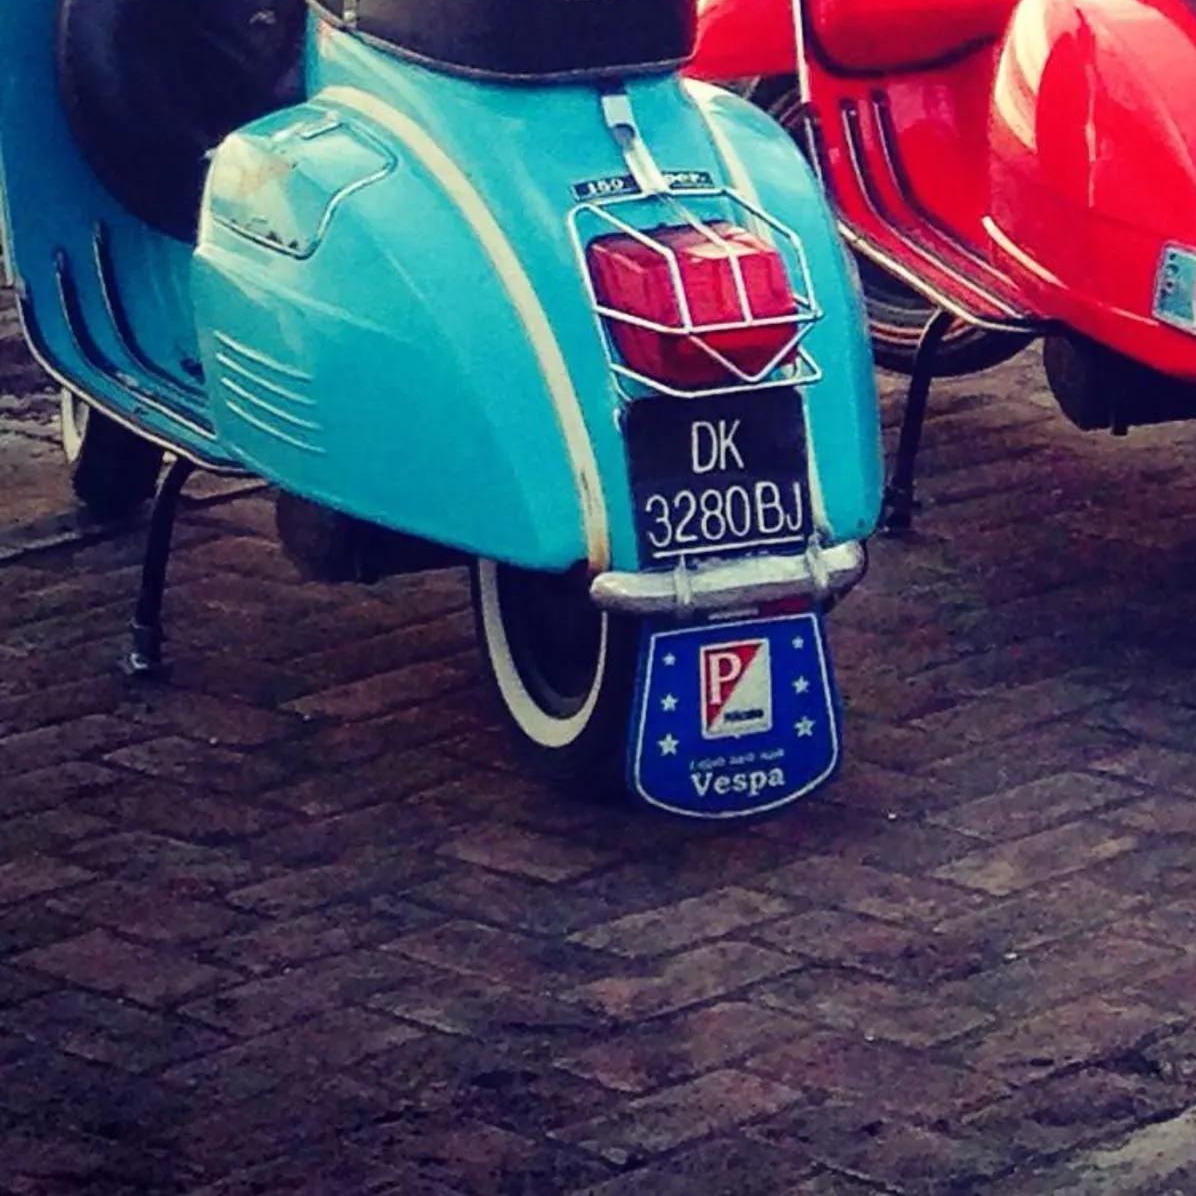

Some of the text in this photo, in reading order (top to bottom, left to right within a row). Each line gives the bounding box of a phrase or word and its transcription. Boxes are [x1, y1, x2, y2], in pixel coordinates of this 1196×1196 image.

[691, 419, 745, 474] DK
[645, 481, 803, 548] 3280BJ
[708, 652, 743, 705] P
[690, 767, 785, 797] Vespa
